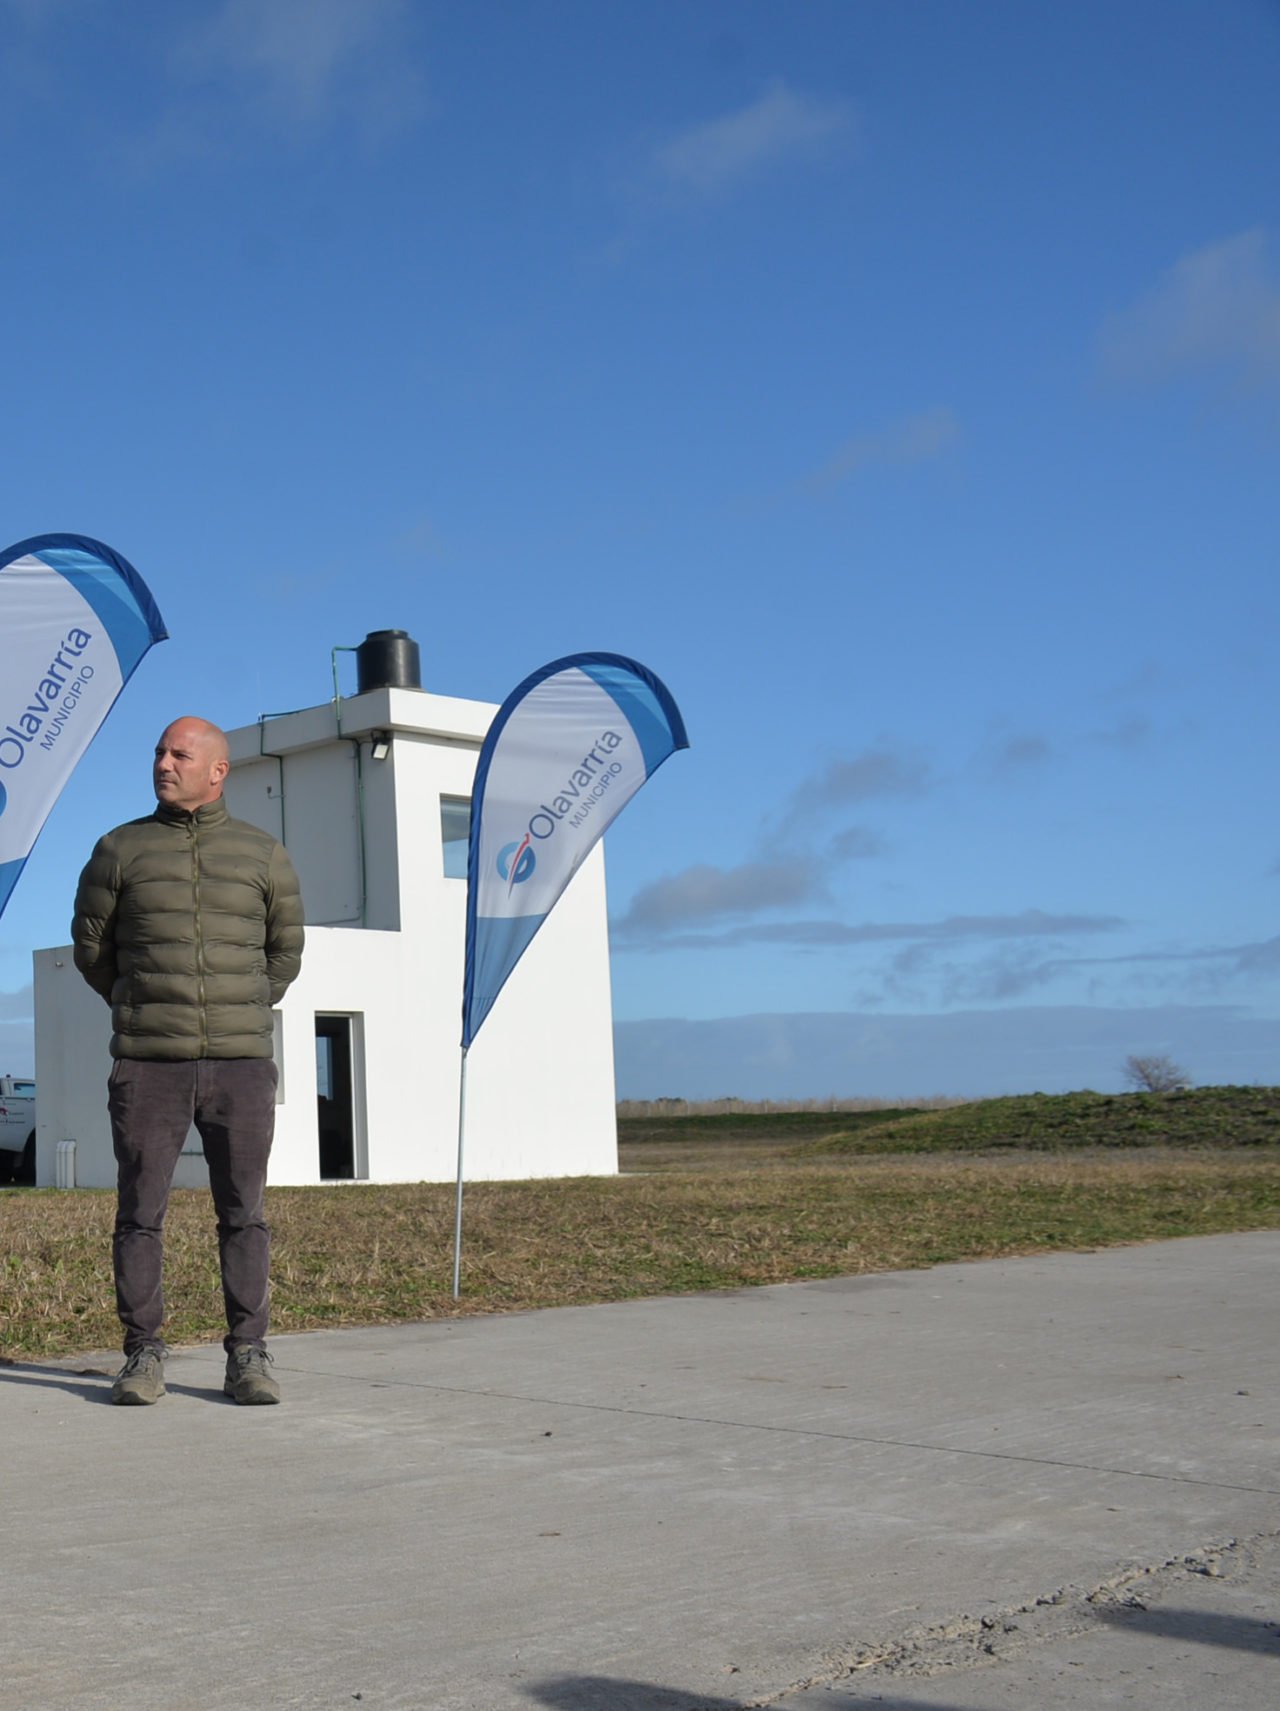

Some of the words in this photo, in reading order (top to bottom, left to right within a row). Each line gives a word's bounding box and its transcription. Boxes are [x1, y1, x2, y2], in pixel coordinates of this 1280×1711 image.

[40, 665, 94, 751] MUNICIPIO
[528, 730, 623, 840] Olavarría
[568, 762, 623, 829] MUNICIPIO
